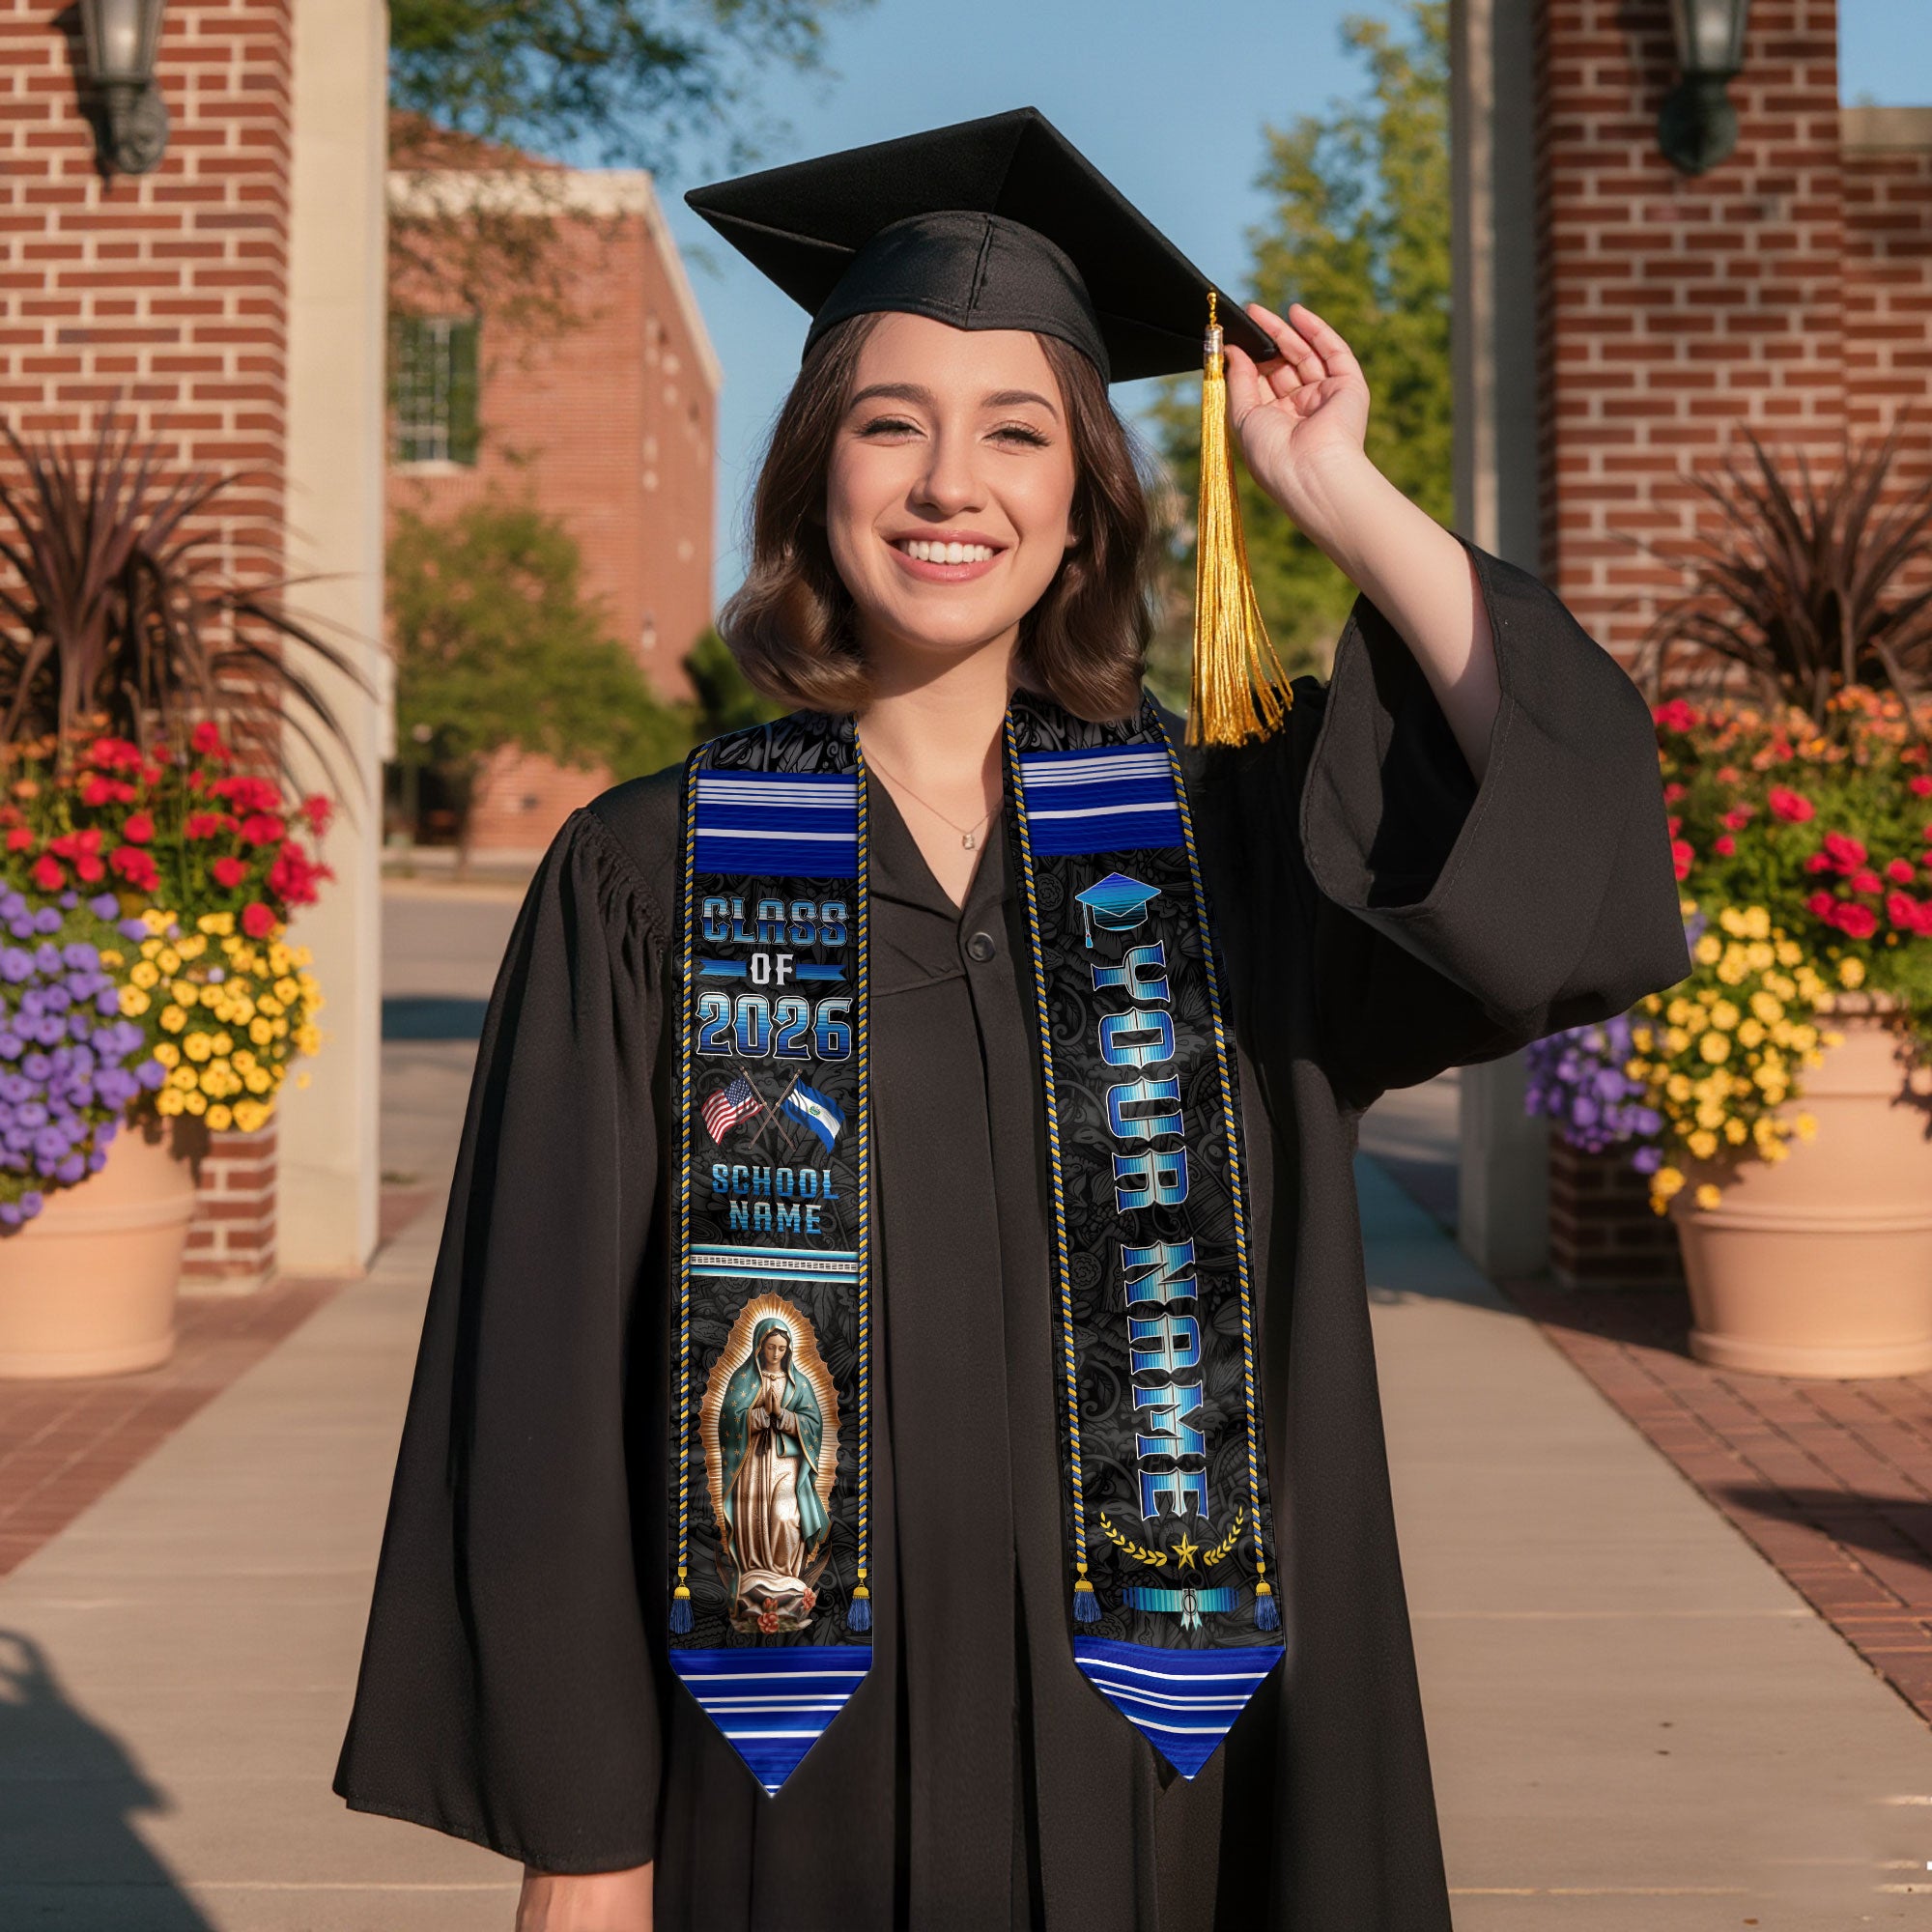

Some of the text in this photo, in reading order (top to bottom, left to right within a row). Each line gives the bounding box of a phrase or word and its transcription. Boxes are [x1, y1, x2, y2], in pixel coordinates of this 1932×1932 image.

[700, 895, 849, 947] CLASS
[750, 952, 794, 985] OF
[695, 991, 852, 1062] 2026
[712, 1163, 839, 1200] SCHOOL
[729, 1201, 822, 1235] NAME
[1091, 940, 1209, 1521] YOUR NAME
